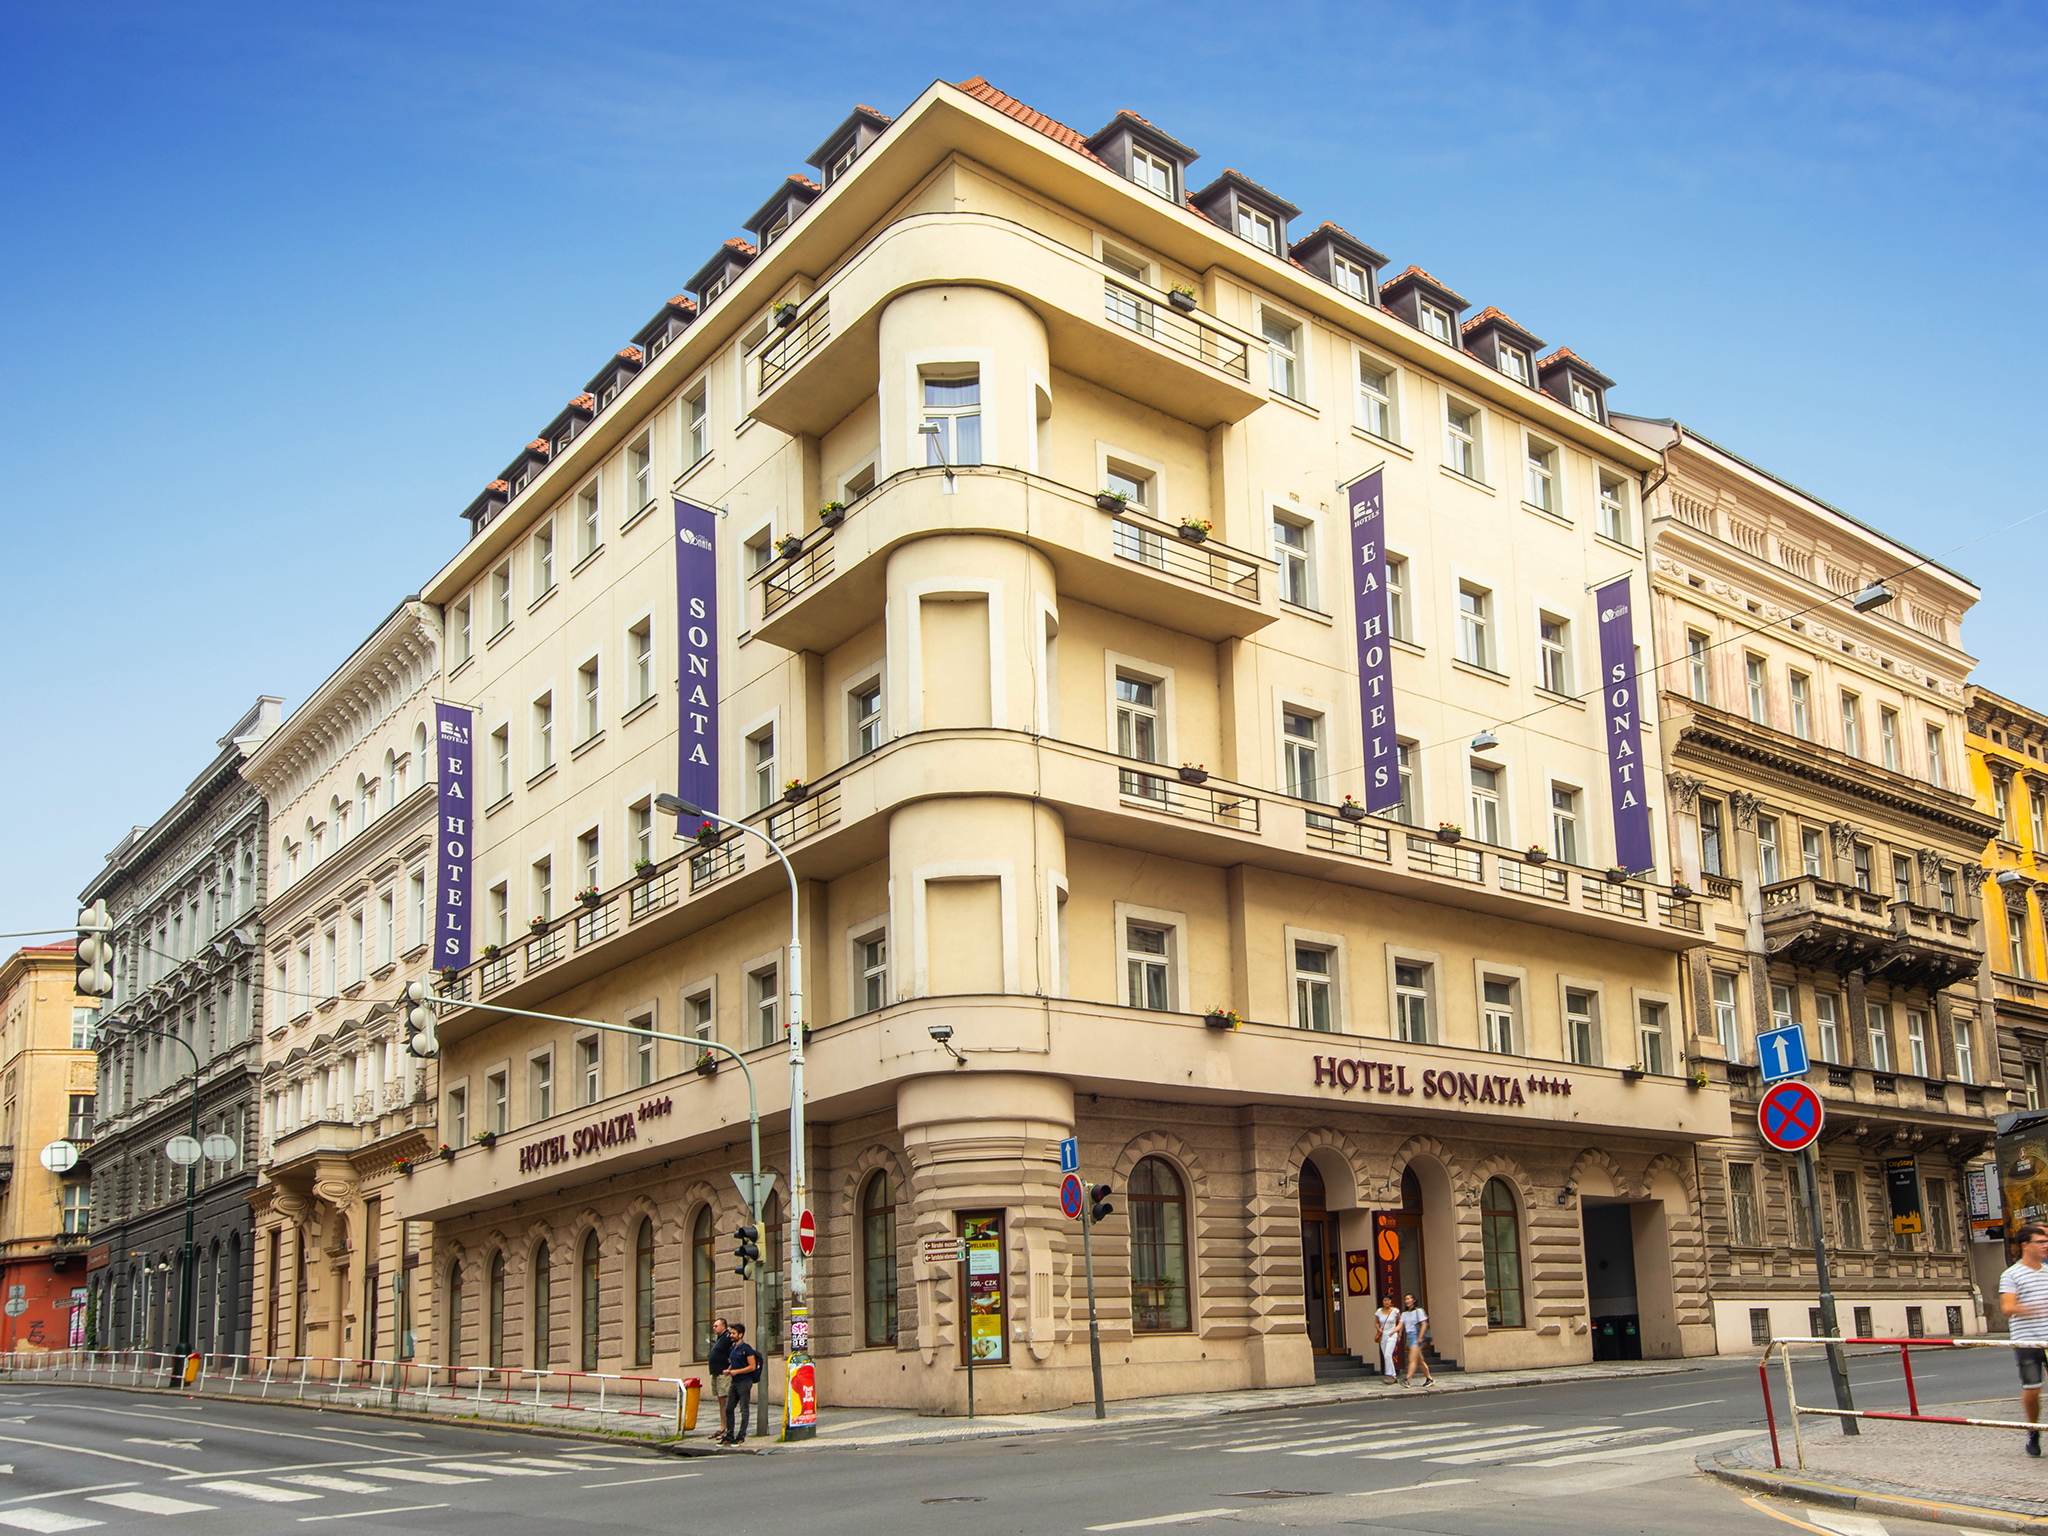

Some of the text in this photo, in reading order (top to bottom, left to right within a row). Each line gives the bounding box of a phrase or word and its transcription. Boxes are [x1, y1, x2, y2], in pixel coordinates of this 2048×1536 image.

[1354, 509, 1380, 529] HOTELS
[688, 597, 710, 766] SONATA
[1361, 541, 1389, 789] EA HOTELS
[441, 733, 469, 746] HOTELS
[1612, 662, 1639, 810] SONATA
[445, 757, 465, 955] EA HOTELS
[1313, 1055, 1526, 1105] HOTEL SONATA
[518, 1112, 637, 1174] HOTEL SONATA
[1888, 1159, 1914, 1168] CityStay
[984, 1279, 998, 1287] CZK
